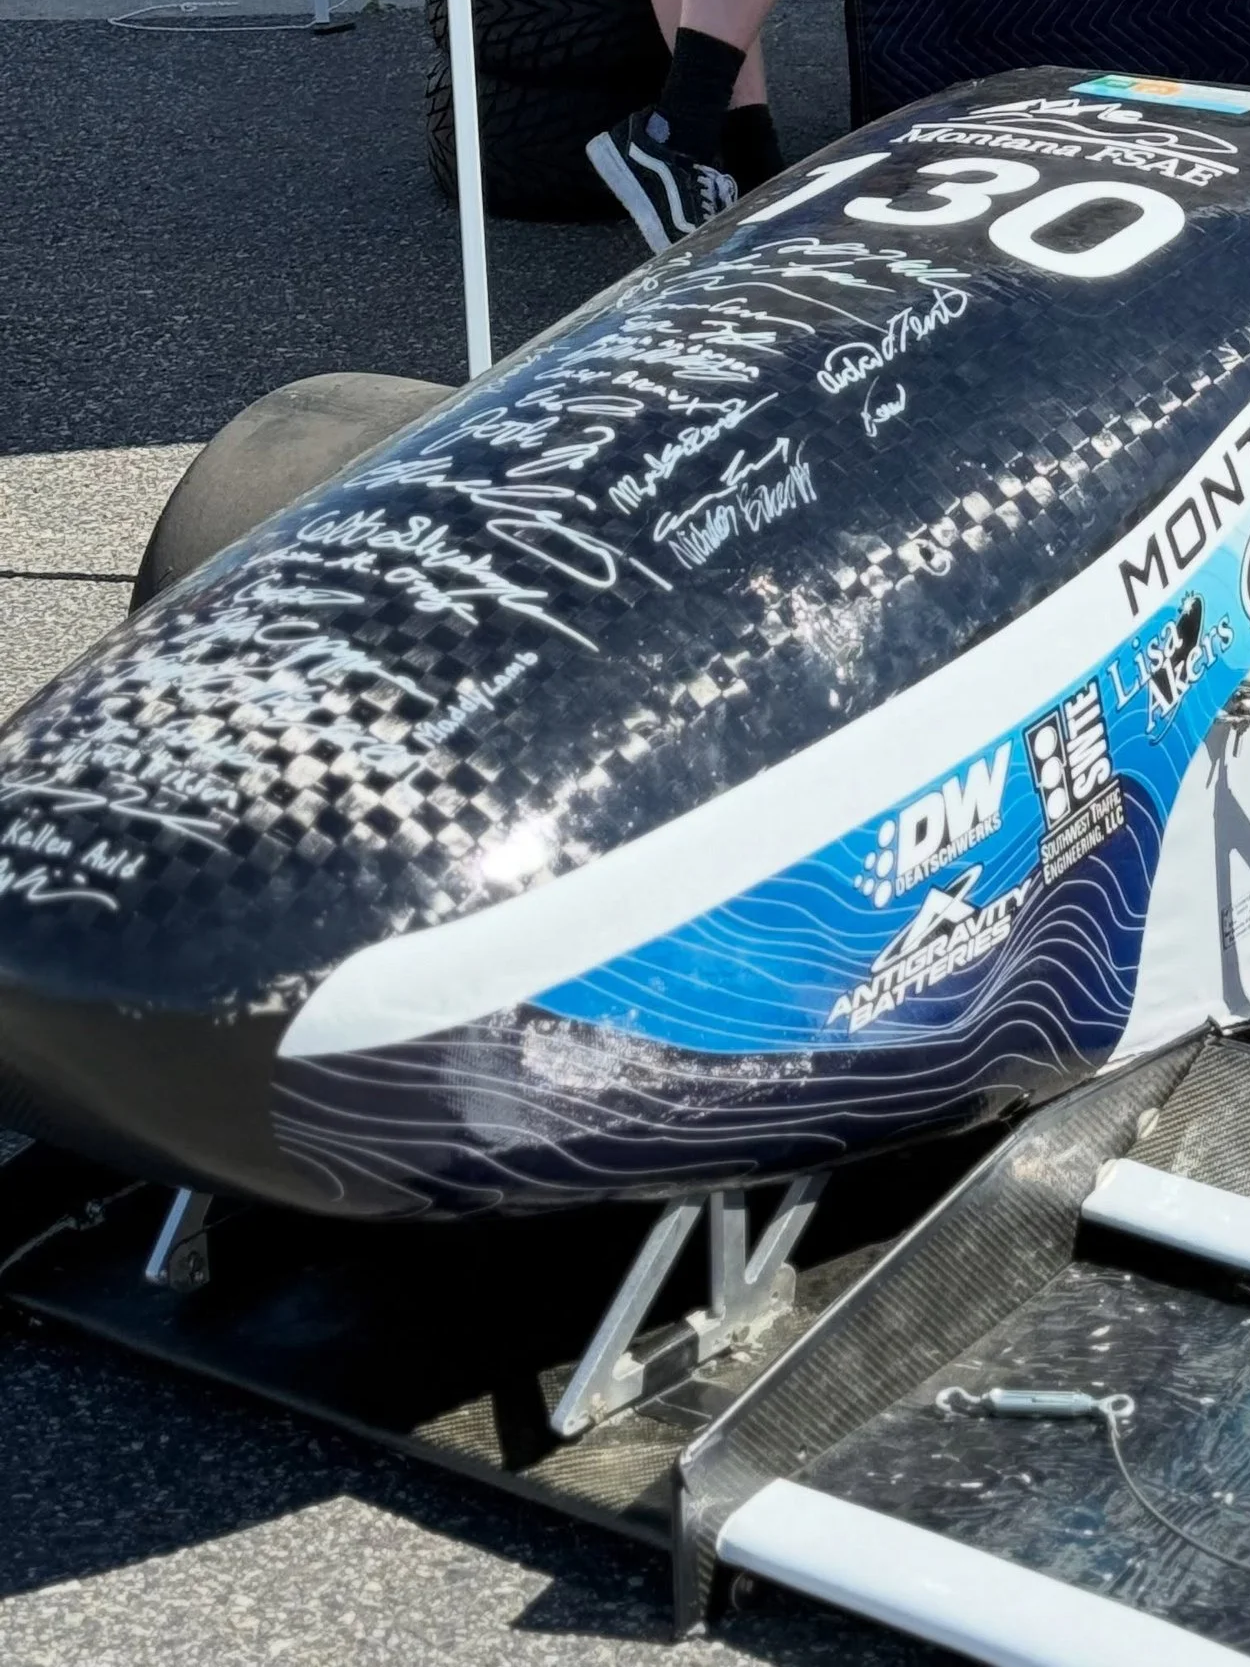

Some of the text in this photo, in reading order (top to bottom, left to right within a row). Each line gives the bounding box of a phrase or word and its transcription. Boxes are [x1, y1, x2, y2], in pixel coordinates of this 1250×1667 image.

[738, 152, 1186, 278] 130
[888, 125, 1223, 187] Montana FSAE
[1106, 621, 1183, 711] Lisa
[1146, 613, 1235, 733] Akers
[1065, 681, 1111, 800] SWTE
[895, 811, 1002, 896] DEATSCHWERKS
[897, 739, 1012, 876] DW
[1105, 805, 1125, 834] LLC
[825, 877, 1033, 1027] ANTIGRAVITY
[850, 914, 1012, 1034] BATTERIES
